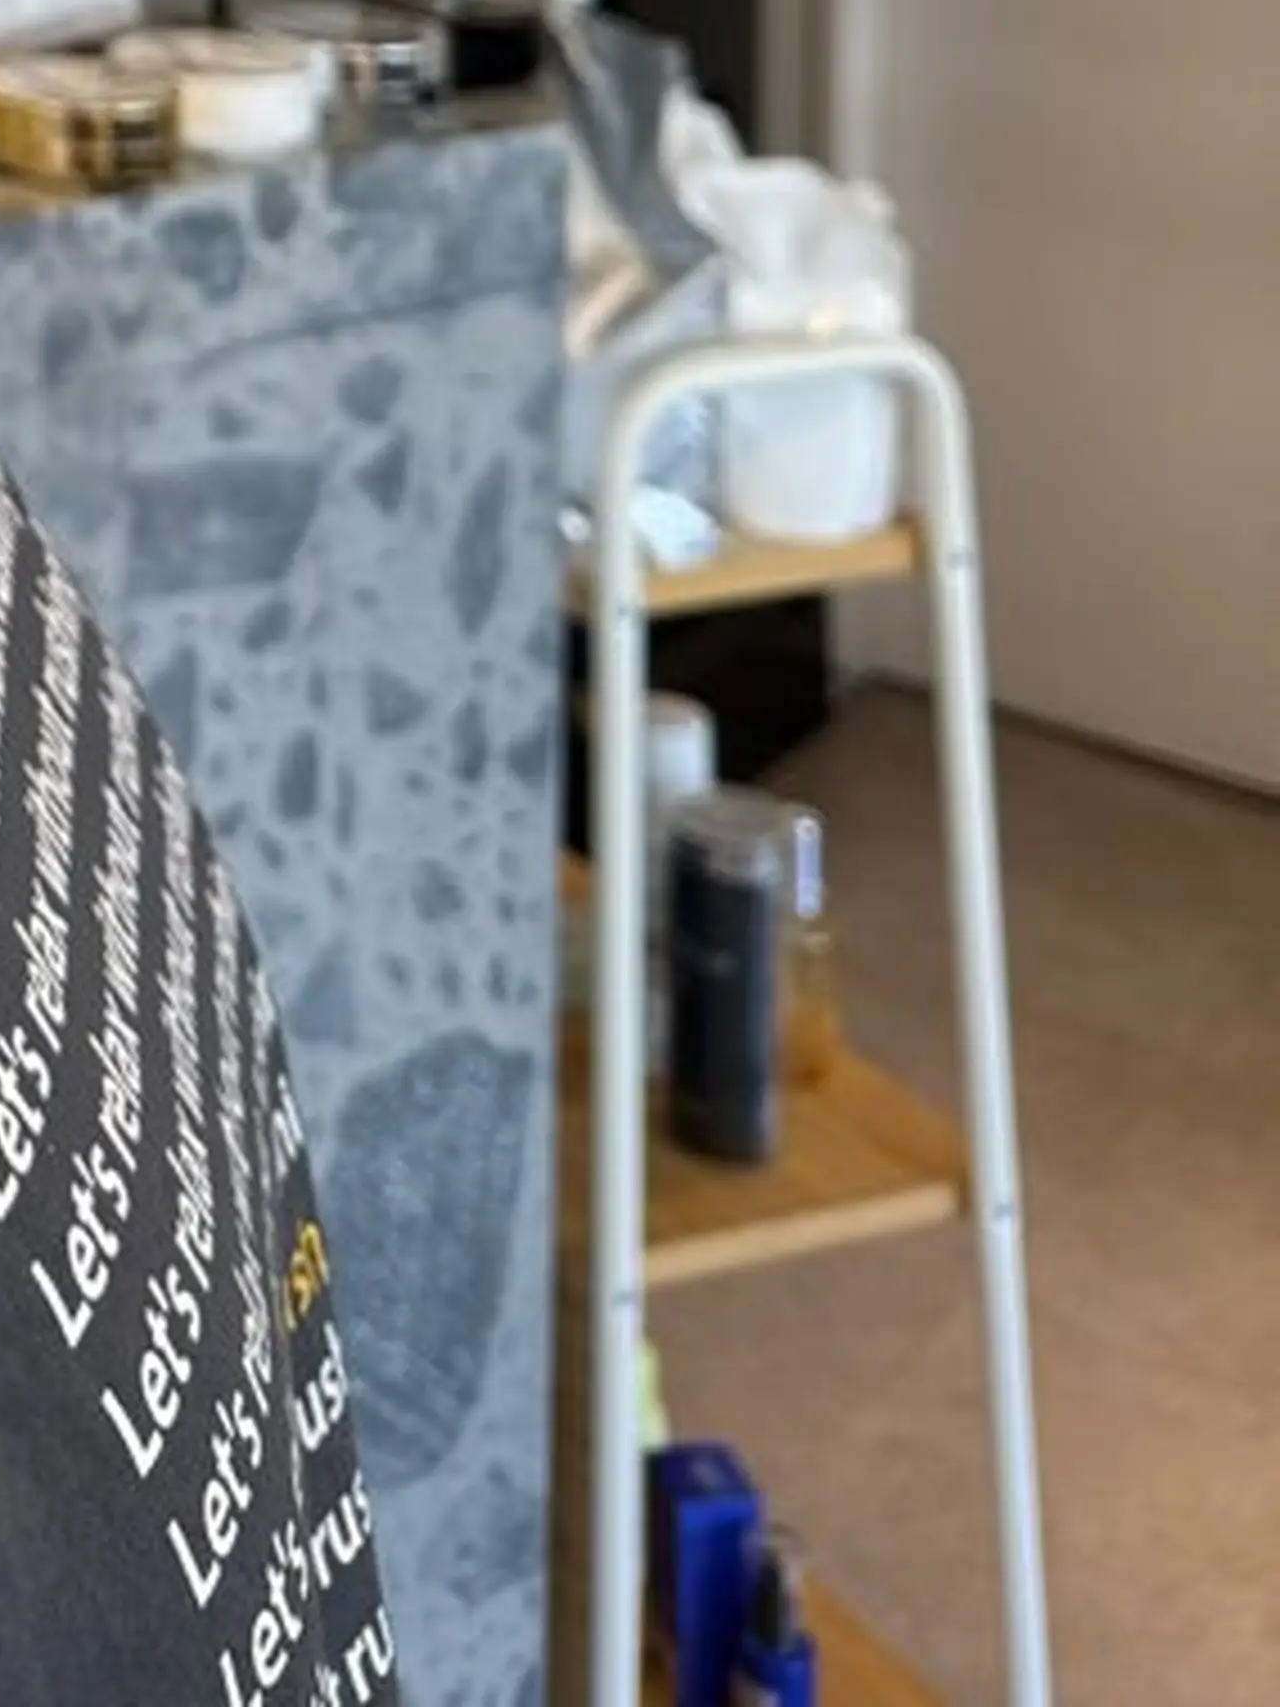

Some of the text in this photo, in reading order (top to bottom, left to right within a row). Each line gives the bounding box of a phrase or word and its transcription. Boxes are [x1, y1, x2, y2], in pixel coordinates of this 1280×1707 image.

[13, 876, 70, 1054] relax
[31, 1142, 130, 1349] Let's
[89, 987, 140, 1173] relax
[101, 1264, 201, 1479] Let's
[166, 1389, 262, 1610] Let's
